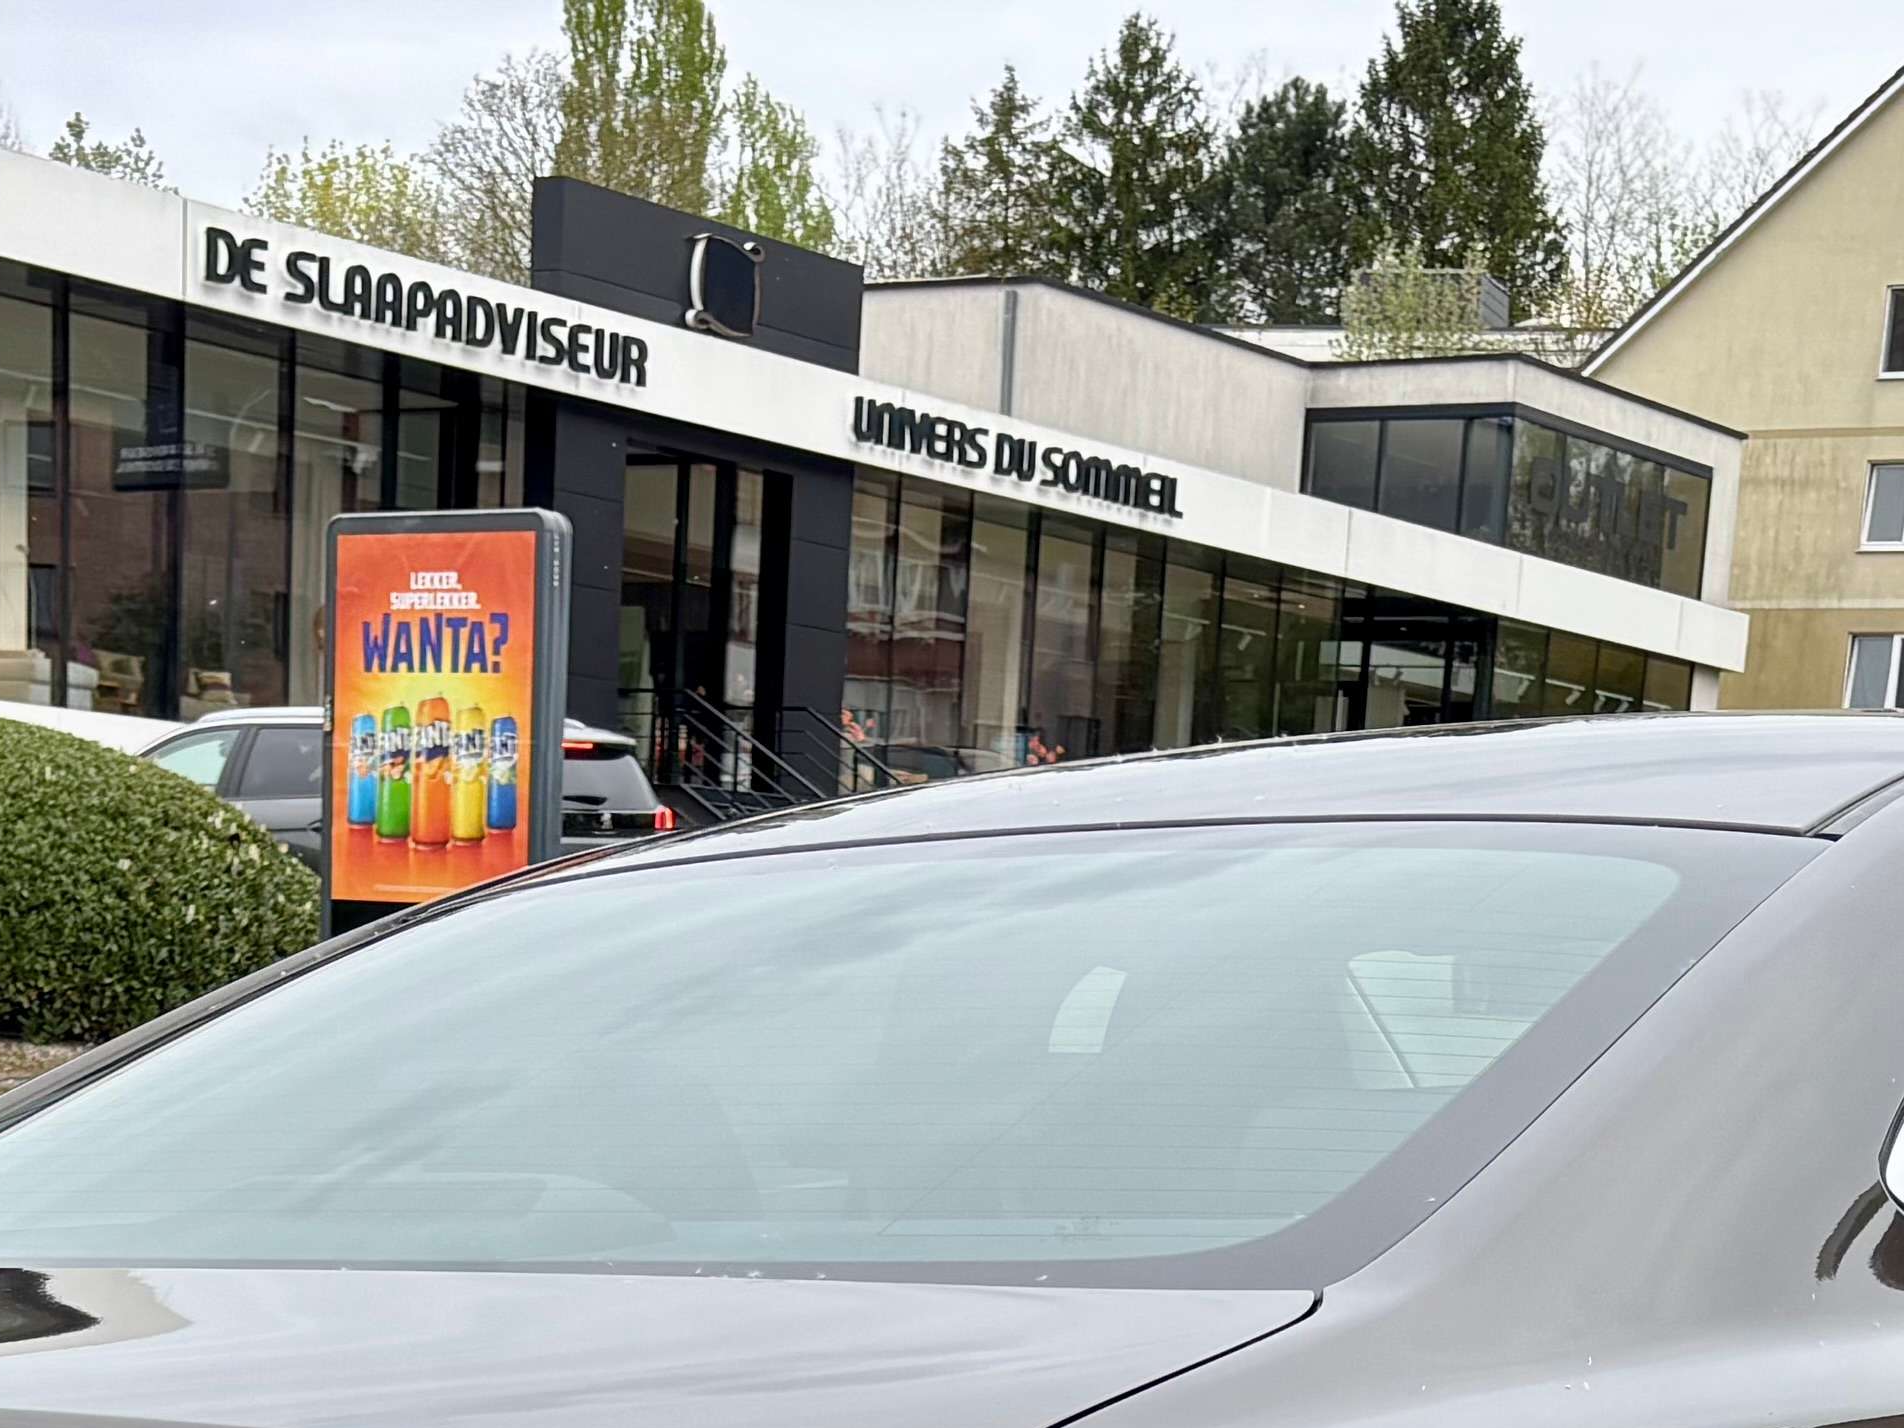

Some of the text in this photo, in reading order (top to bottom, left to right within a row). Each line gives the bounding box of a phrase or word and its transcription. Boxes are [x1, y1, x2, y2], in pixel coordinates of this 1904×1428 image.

[205, 226, 649, 388] DE SLAAPADVISEUR
[854, 396, 1184, 519] UNIVERS DU SOMMEIL
[362, 612, 509, 674] WANTA?
